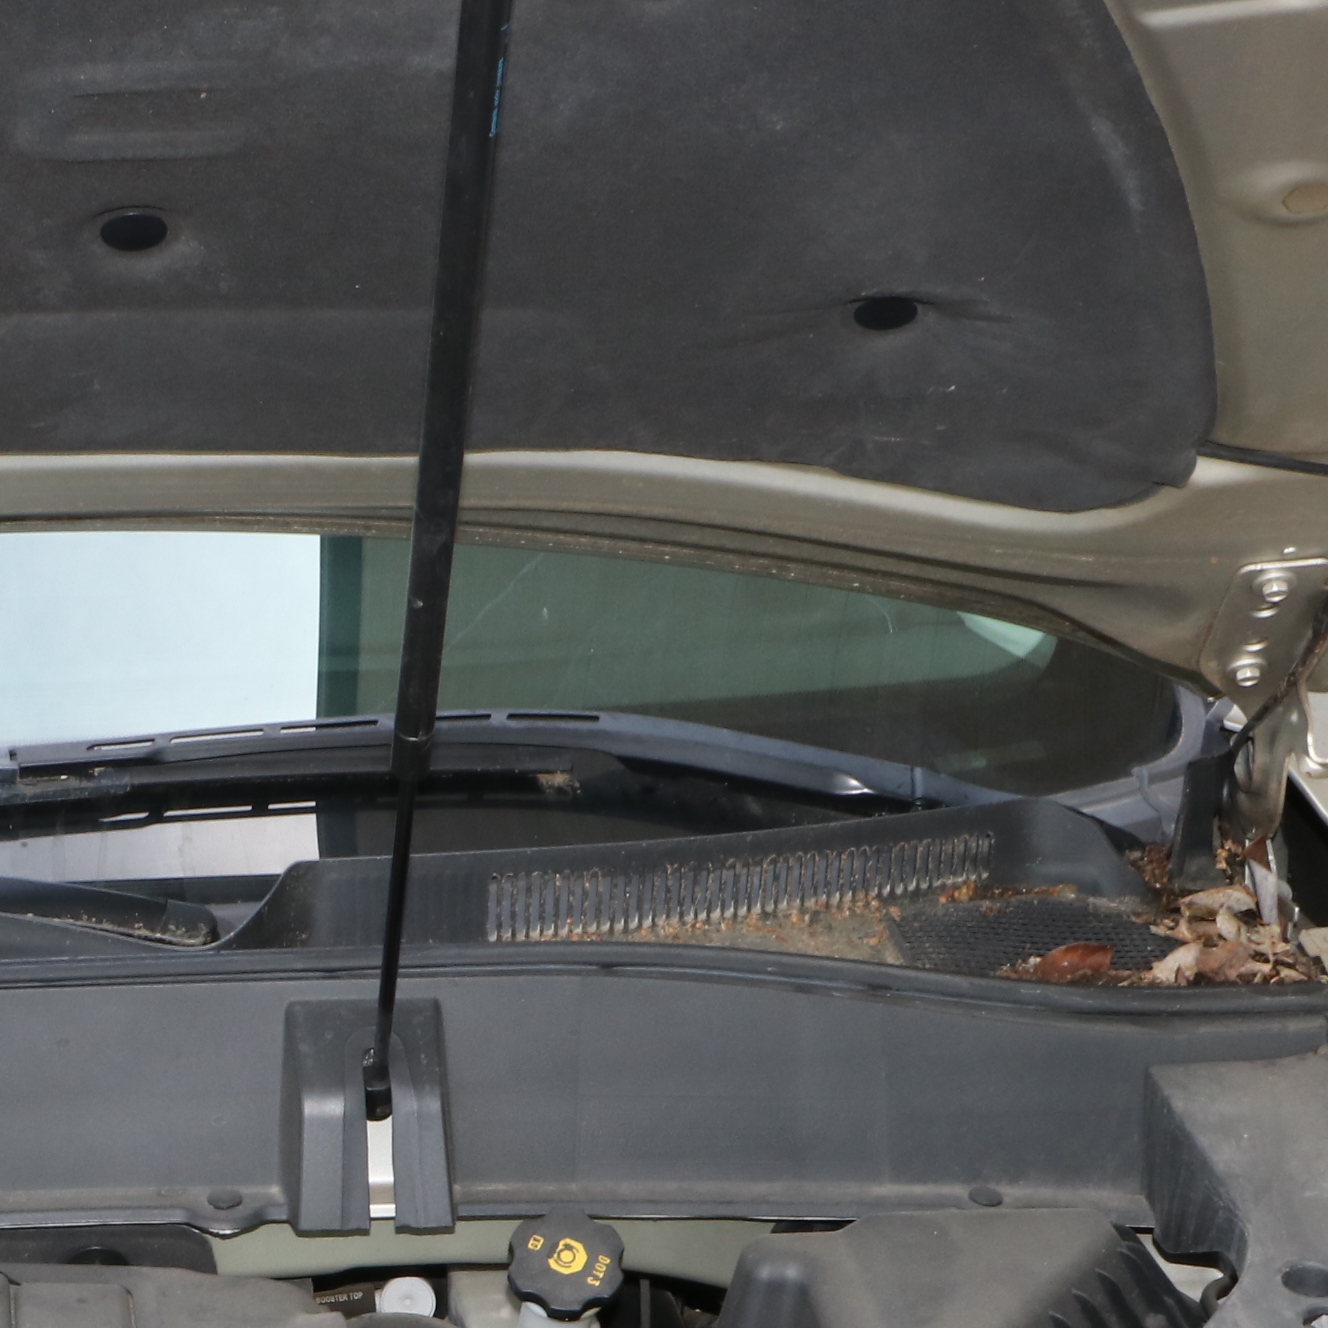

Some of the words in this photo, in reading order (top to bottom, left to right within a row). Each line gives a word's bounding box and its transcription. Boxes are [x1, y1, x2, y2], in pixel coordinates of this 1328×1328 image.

[592, 1255, 611, 1278] DOT
[587, 1276, 600, 1286] 3
[315, 1294, 348, 1303] BOOSTER
[349, 1291, 363, 1300] TOP
